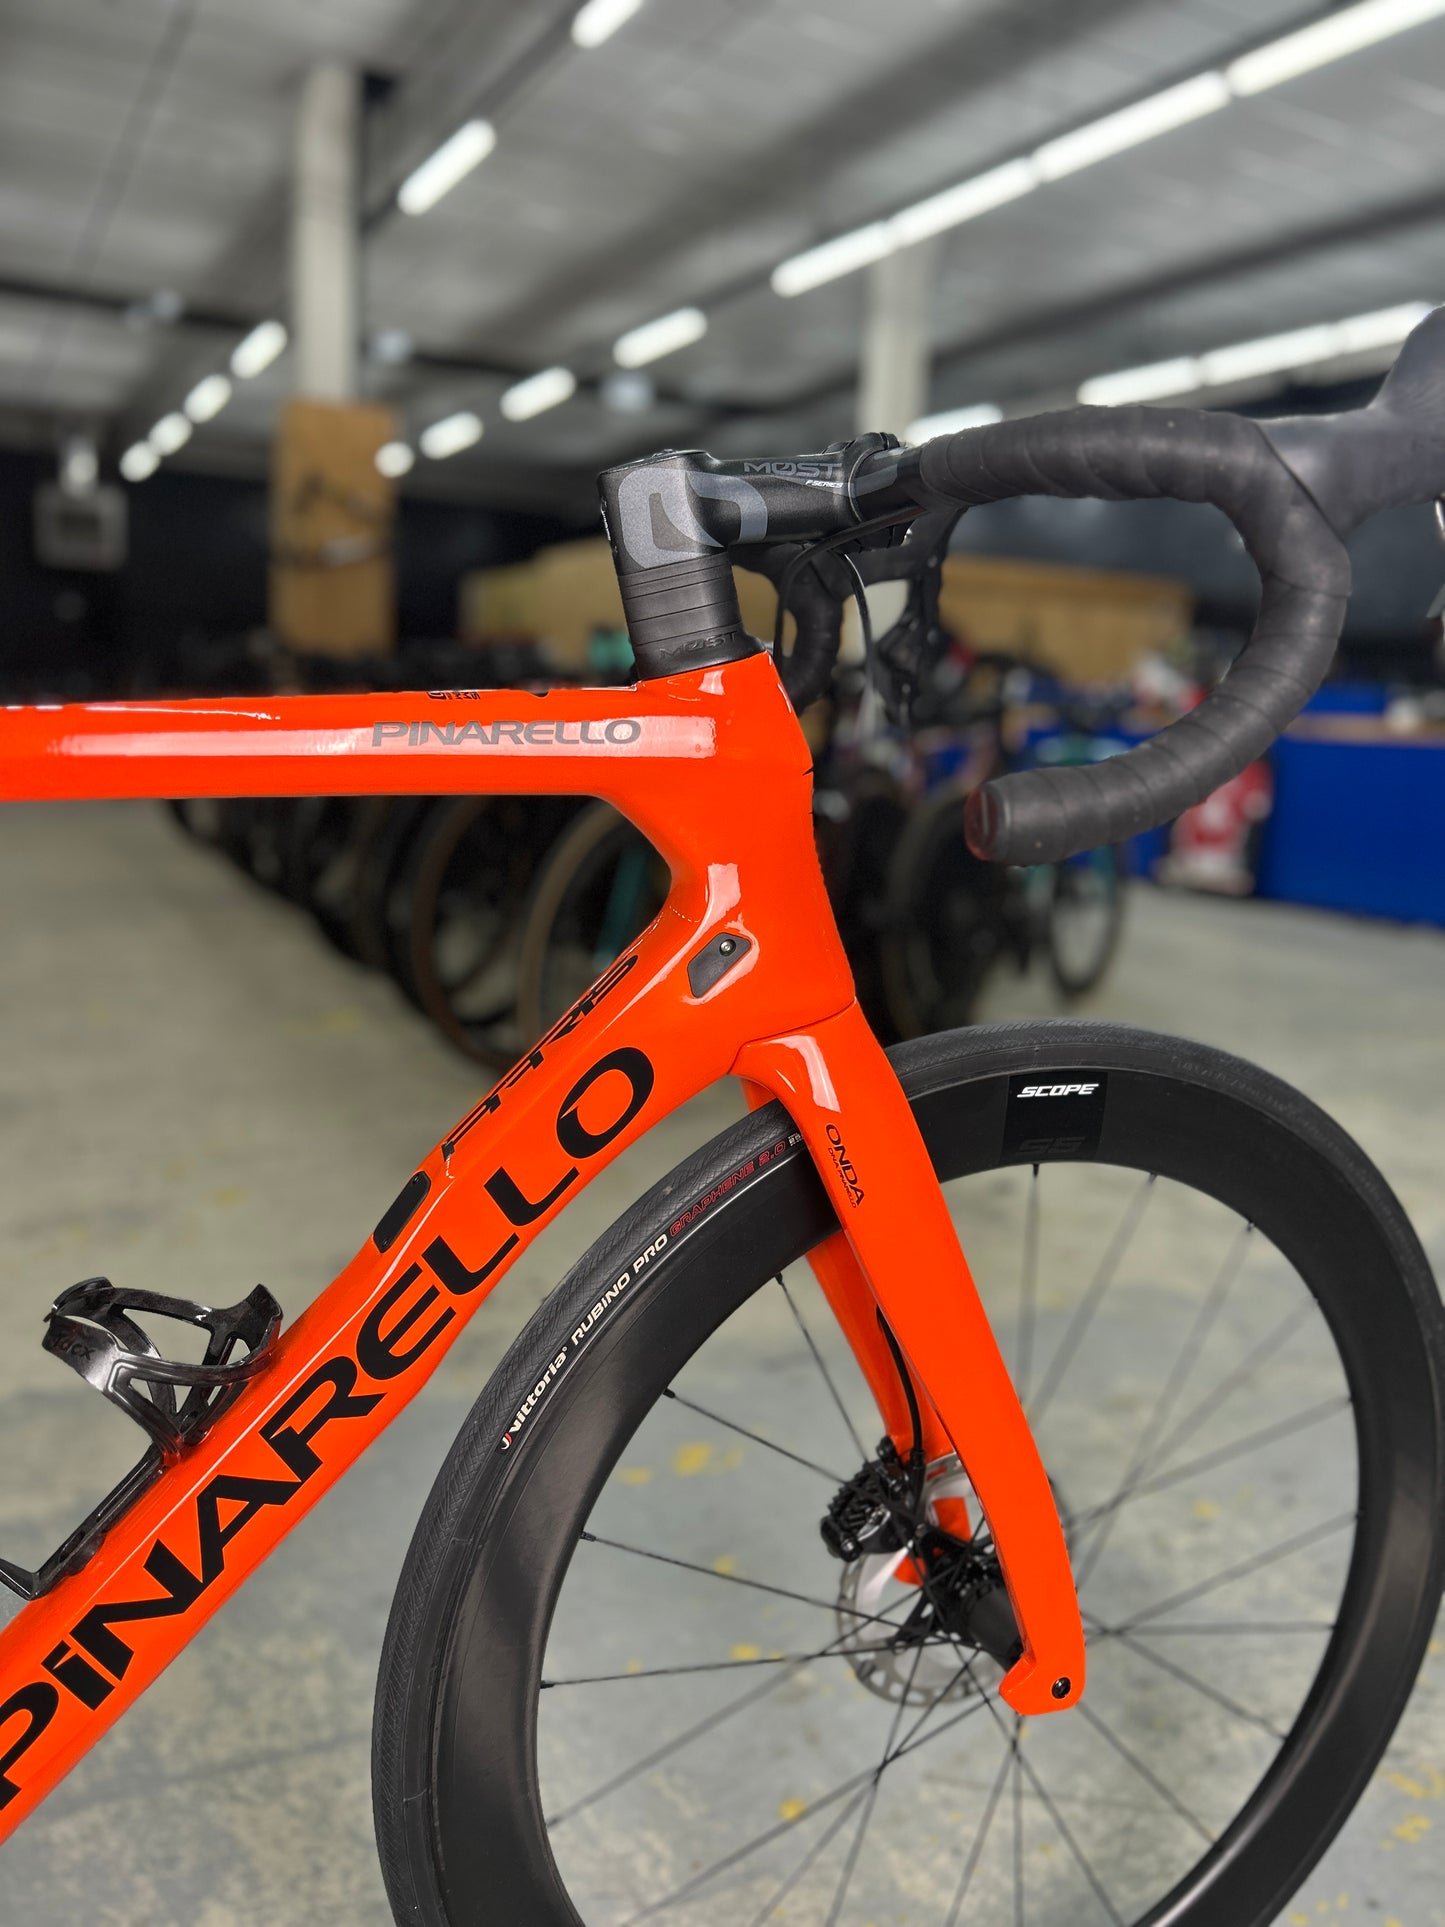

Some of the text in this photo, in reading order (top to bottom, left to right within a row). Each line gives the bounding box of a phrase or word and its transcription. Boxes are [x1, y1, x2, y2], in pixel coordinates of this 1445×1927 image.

[372, 719, 641, 747] PINARELLO
[1016, 1083, 1100, 1098] SCOPE
[826, 1123, 865, 1206] ONDA
[571, 1272, 631, 1345] RUBINO
[632, 1233, 668, 1273] PRO
[669, 1160, 755, 1237] GRAPHENE
[758, 1140, 786, 1166] 2.0
[0, 1046, 655, 1816] PINARELLO
